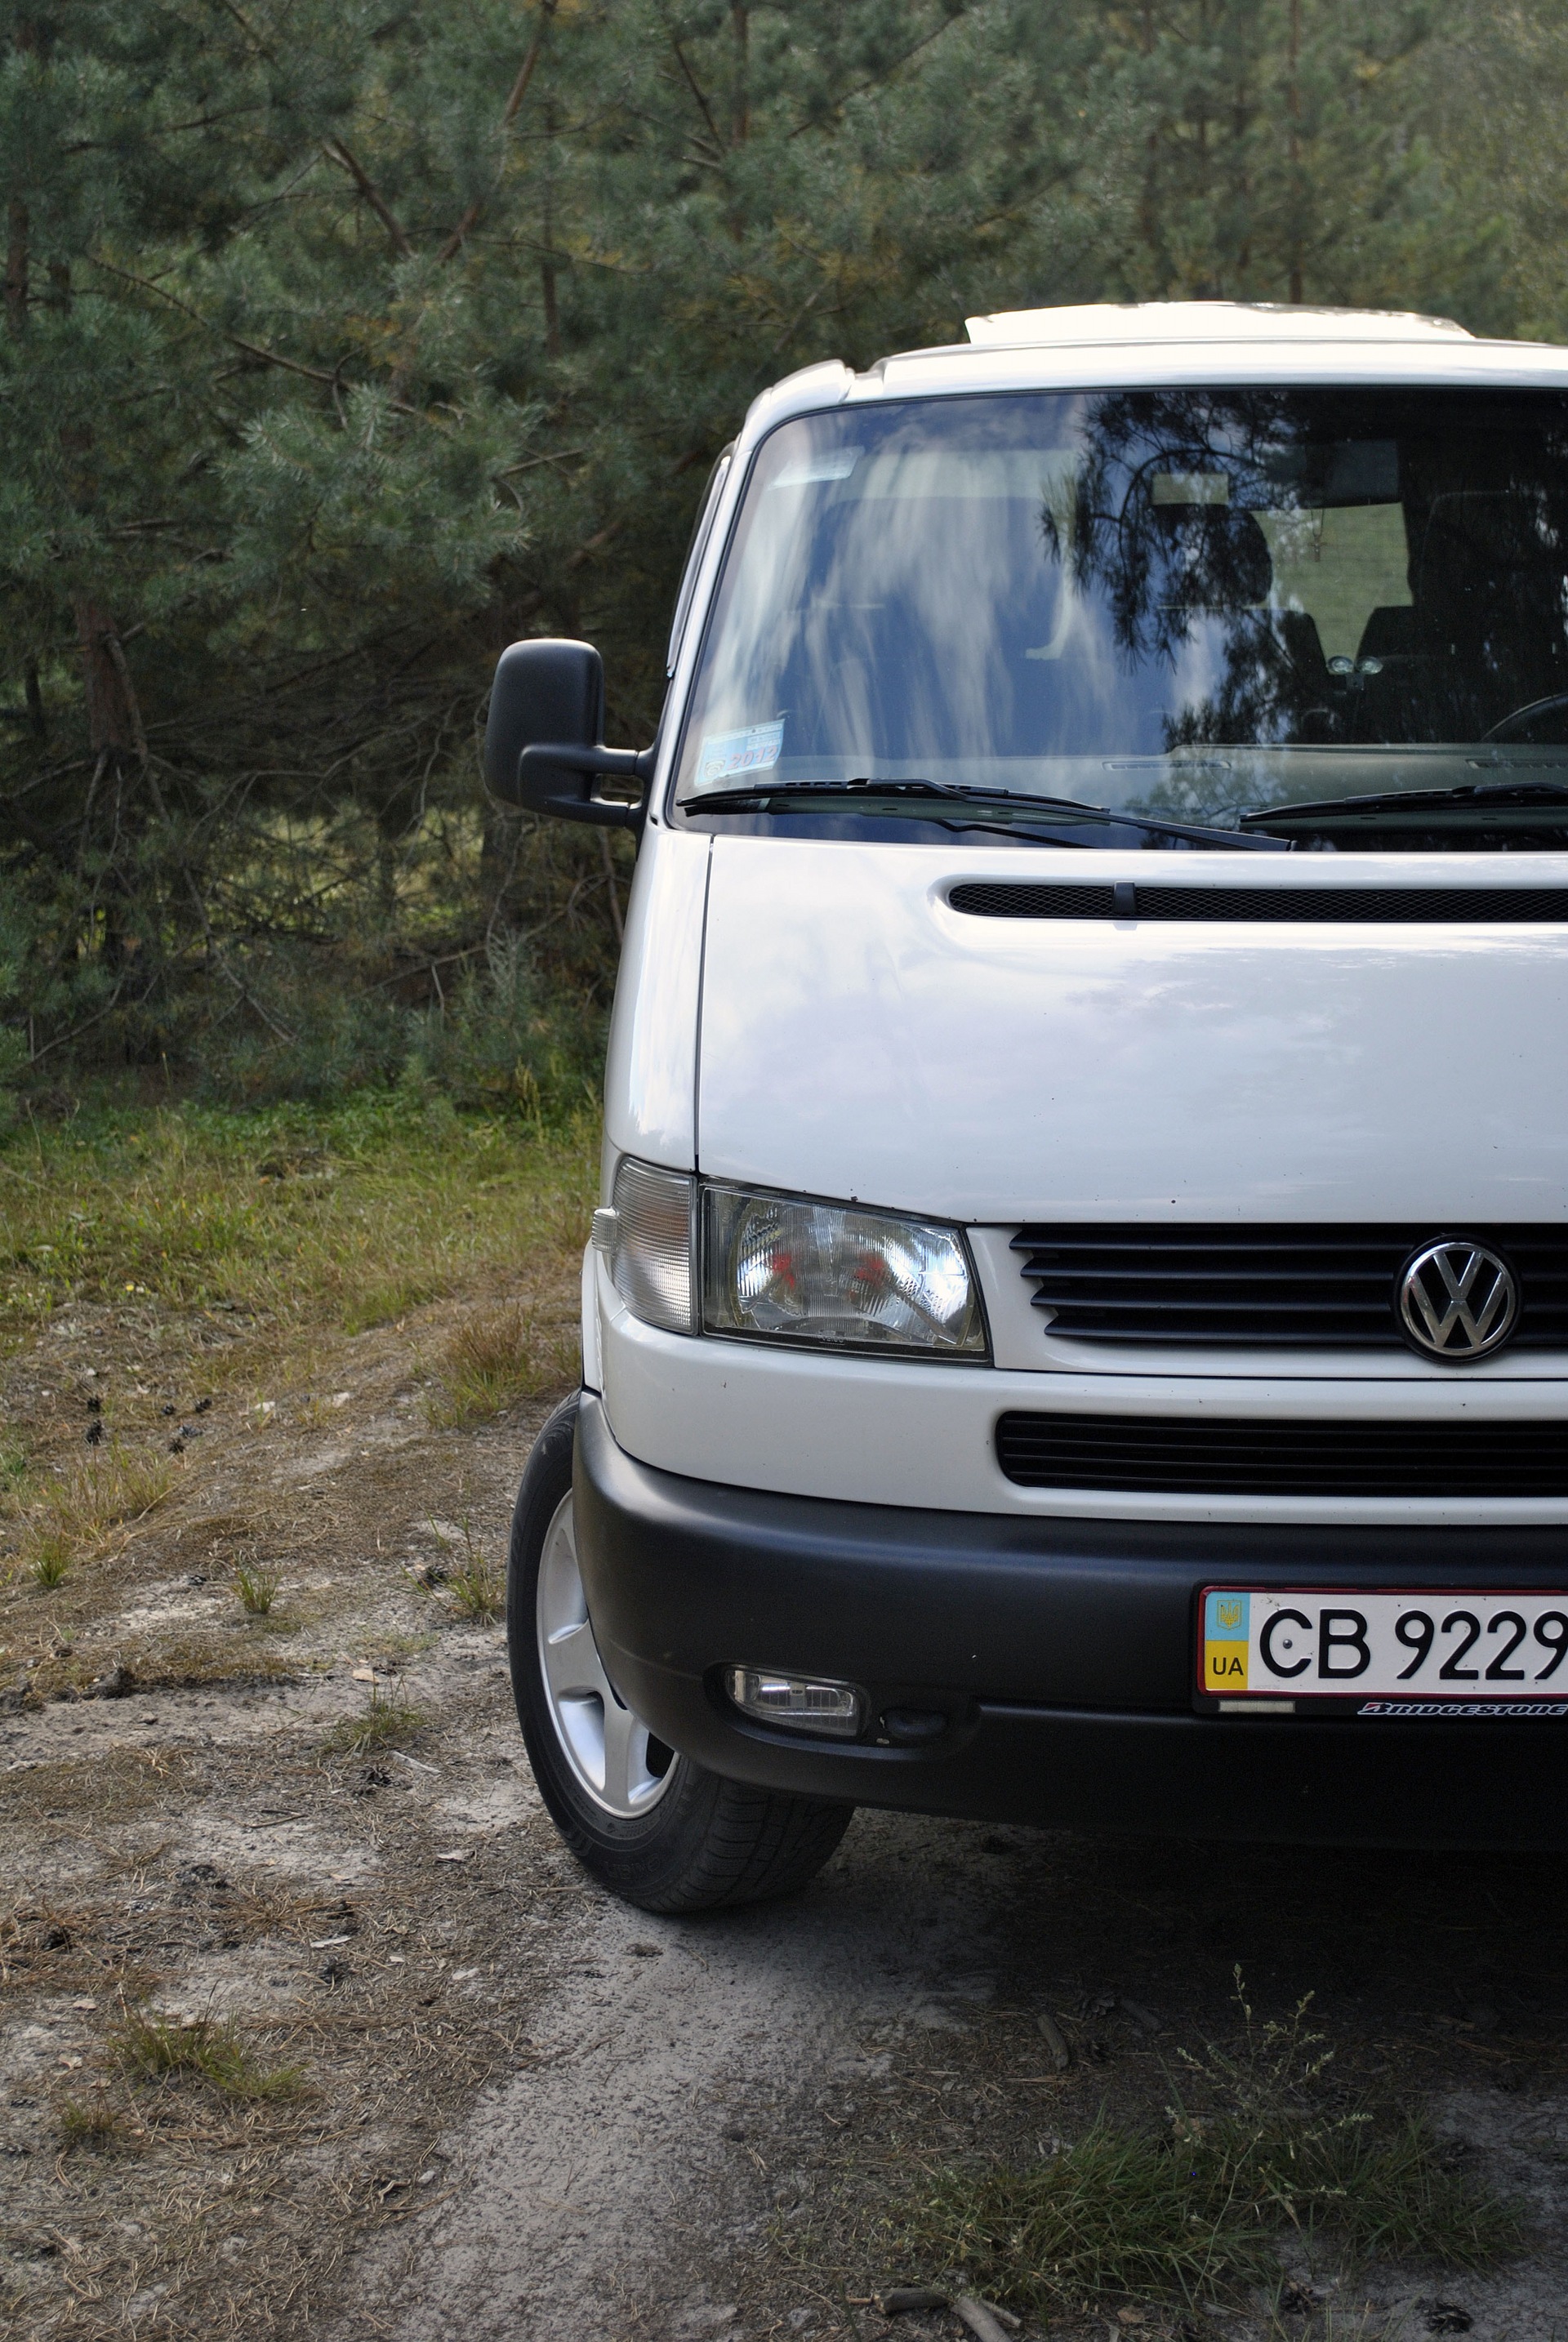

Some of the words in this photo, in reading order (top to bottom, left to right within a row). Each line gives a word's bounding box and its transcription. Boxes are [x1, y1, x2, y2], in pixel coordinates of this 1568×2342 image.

[727, 745, 777, 770] 2012
[1402, 1243, 1515, 1356] VW
[1259, 1609, 1370, 1679] CB
[1395, 1610, 1568, 1680] 9229
[1213, 1657, 1244, 1676] UA
[1357, 1703, 1568, 1715] BRIDGESTONE
